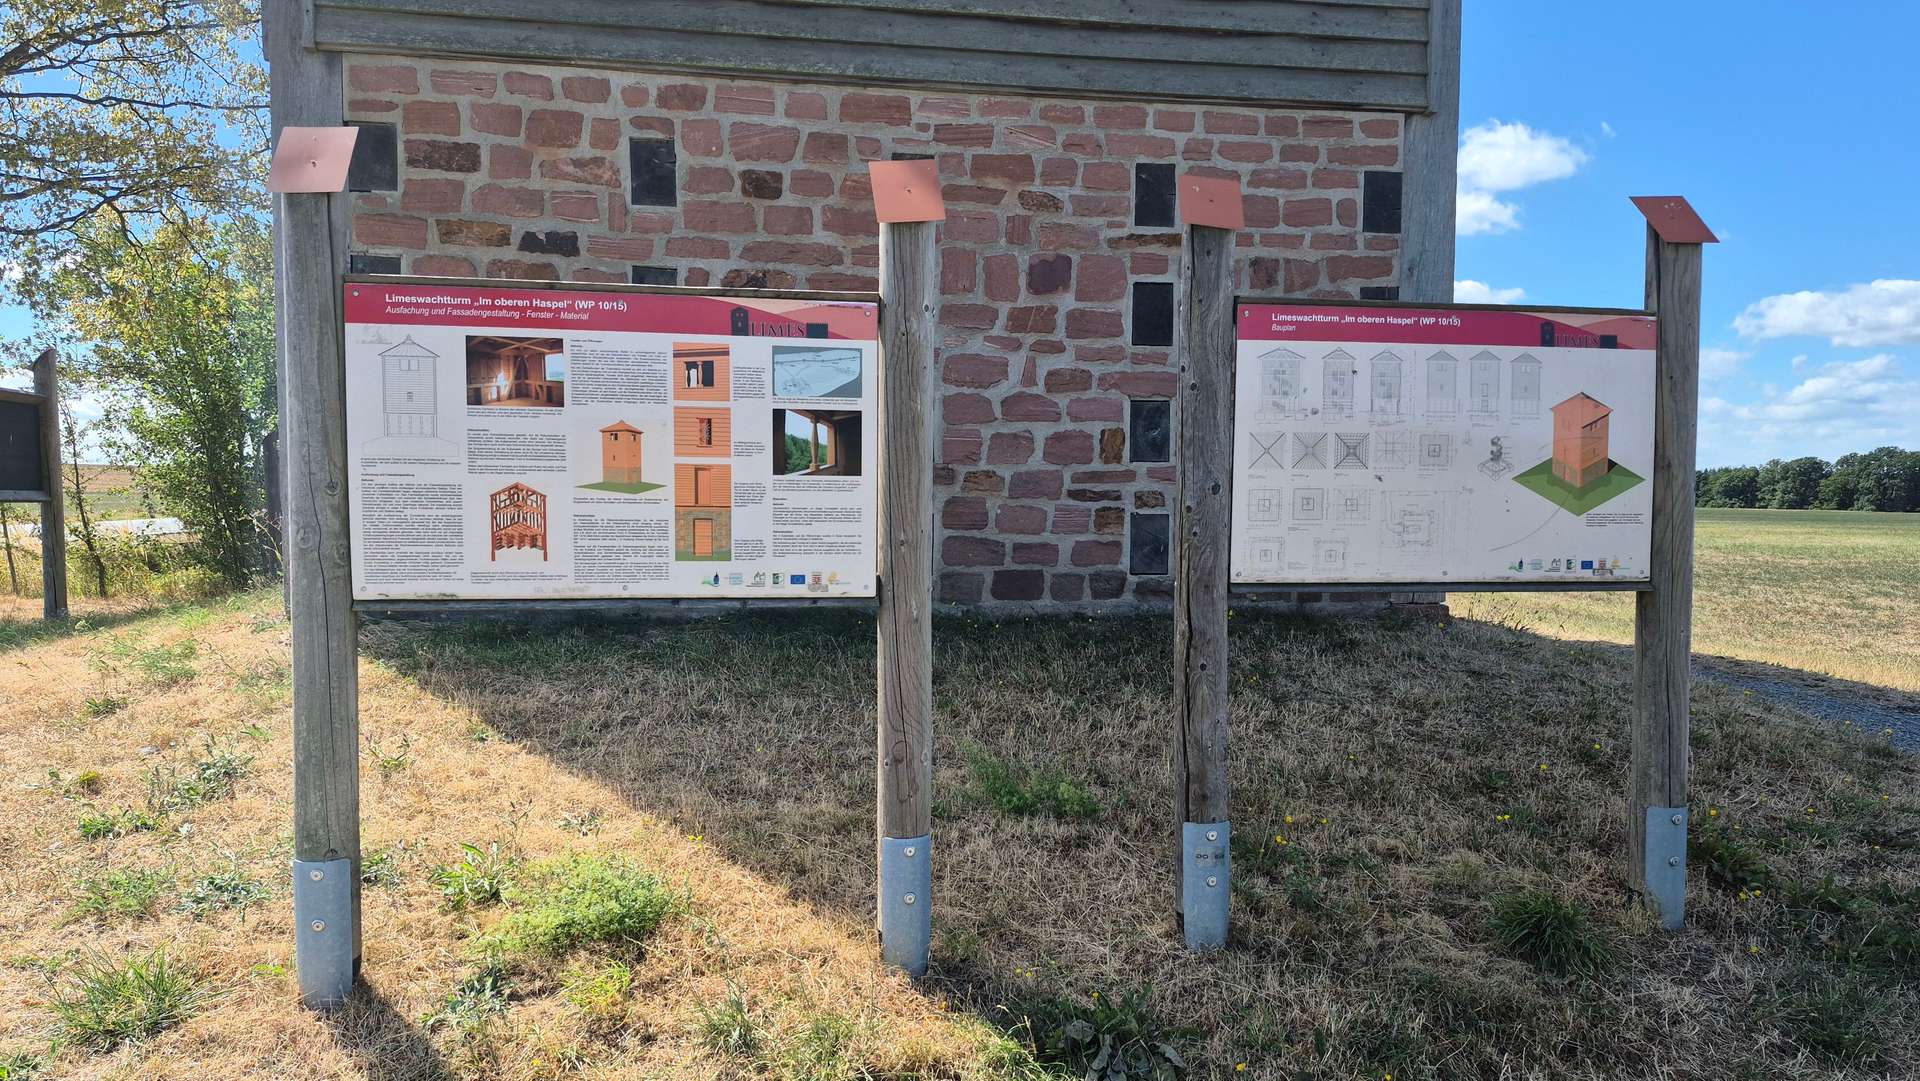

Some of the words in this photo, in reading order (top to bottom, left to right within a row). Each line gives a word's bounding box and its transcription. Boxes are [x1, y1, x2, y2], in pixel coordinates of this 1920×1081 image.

[385, 293, 471, 305] Limeswachtturm
[474, 296, 492, 306] „Im
[494, 298, 530, 307] oberen
[575, 300, 595, 310] (WP
[599, 300, 627, 312] 10/15)
[385, 306, 429, 316] Ausfachung
[431, 307, 445, 315] und
[447, 307, 520, 319] Fassadengestaltung
[526, 310, 554, 319] Fenster
[560, 312, 590, 320] Material
[1271, 313, 1339, 323] Limeswachtturm
[1357, 315, 1385, 324] oberen
[1420, 317, 1436, 327] (WP
[1438, 317, 1461, 327] 10/15)
[750, 322, 806, 338] LIMES
[1271, 323, 1297, 332] Bauplan
